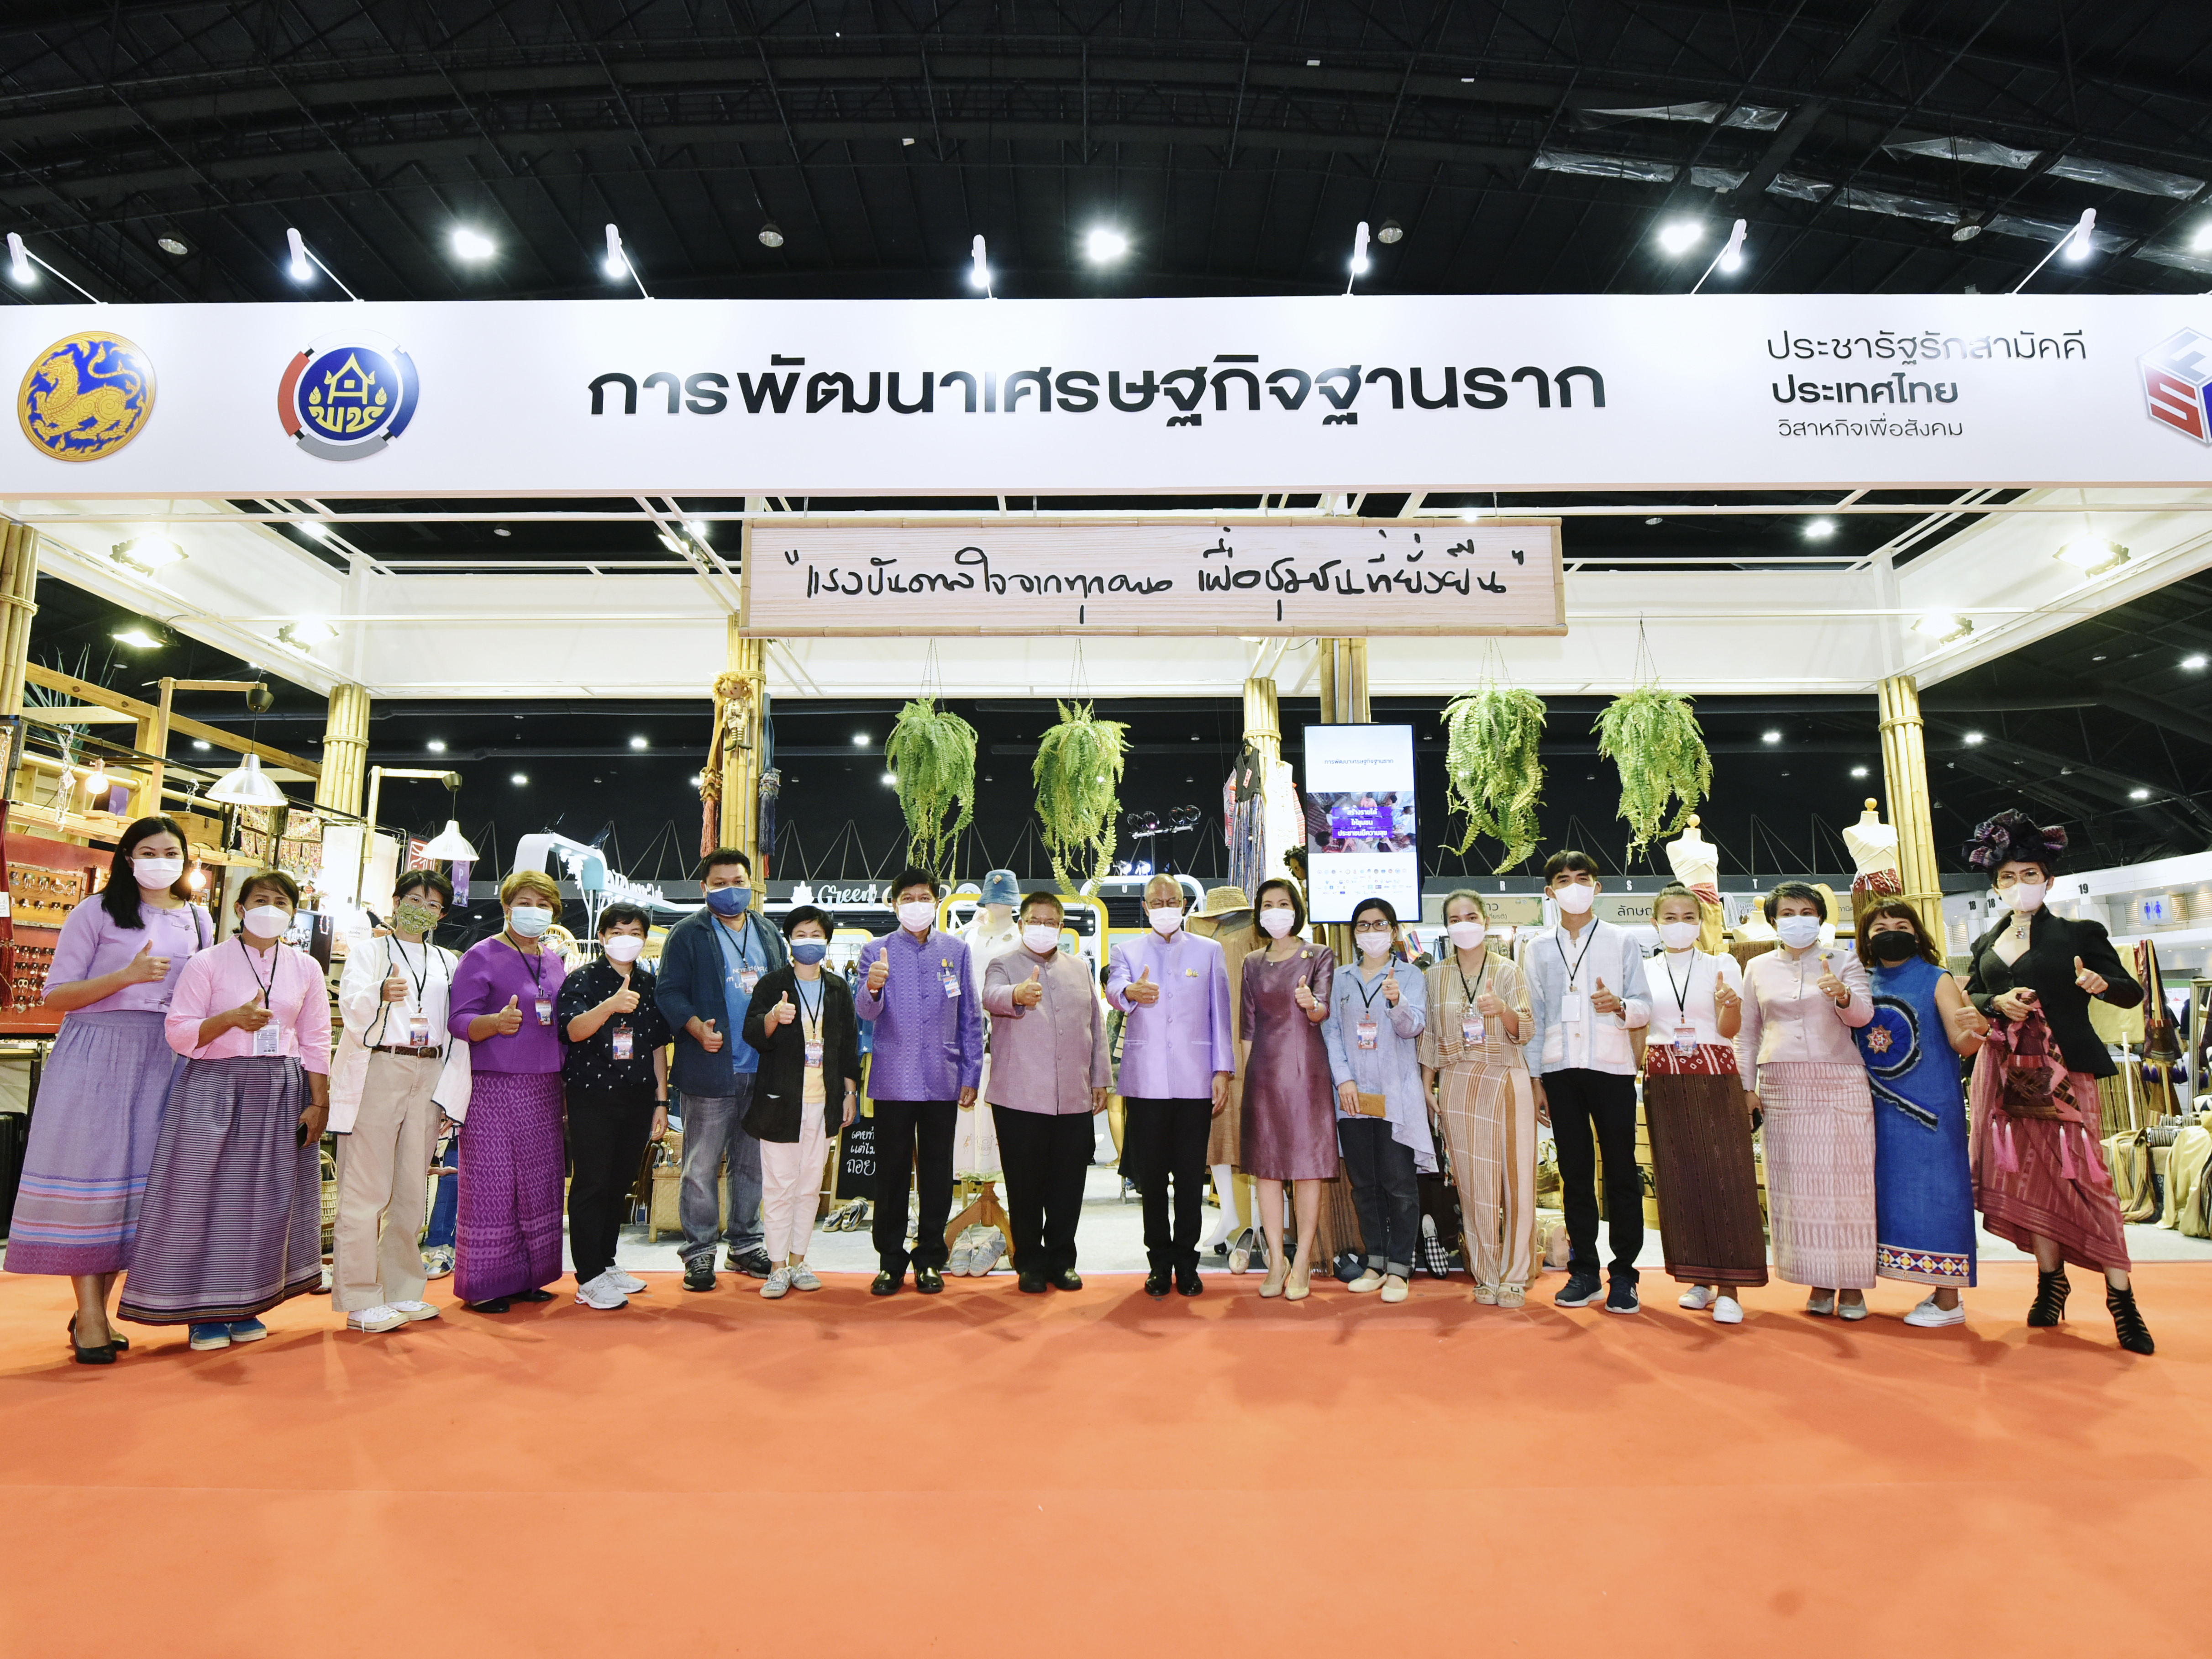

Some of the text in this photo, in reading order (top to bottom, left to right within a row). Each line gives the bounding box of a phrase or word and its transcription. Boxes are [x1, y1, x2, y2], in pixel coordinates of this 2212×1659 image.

[1767, 330, 2086, 365] ประชารัฐรักสามัคคี
[588, 354, 1605, 426] การพัฒนาเศรษฐกิจฐานราก
[1772, 372, 1959, 403] ประเทศไทย
[1778, 413, 1963, 436] วิสาหกิจเพื่อสังคม
[1350, 818, 1373, 828] ให้ชุมชน
[1500, 881, 1506, 891] R
[1626, 880, 1632, 891] S
[1752, 878, 1758, 889] T
[2078, 883, 2089, 894] 19
[1968, 900, 1977, 910] 18
[1986, 898, 1996, 908] 18
[846, 1159, 876, 1176] ถอย
